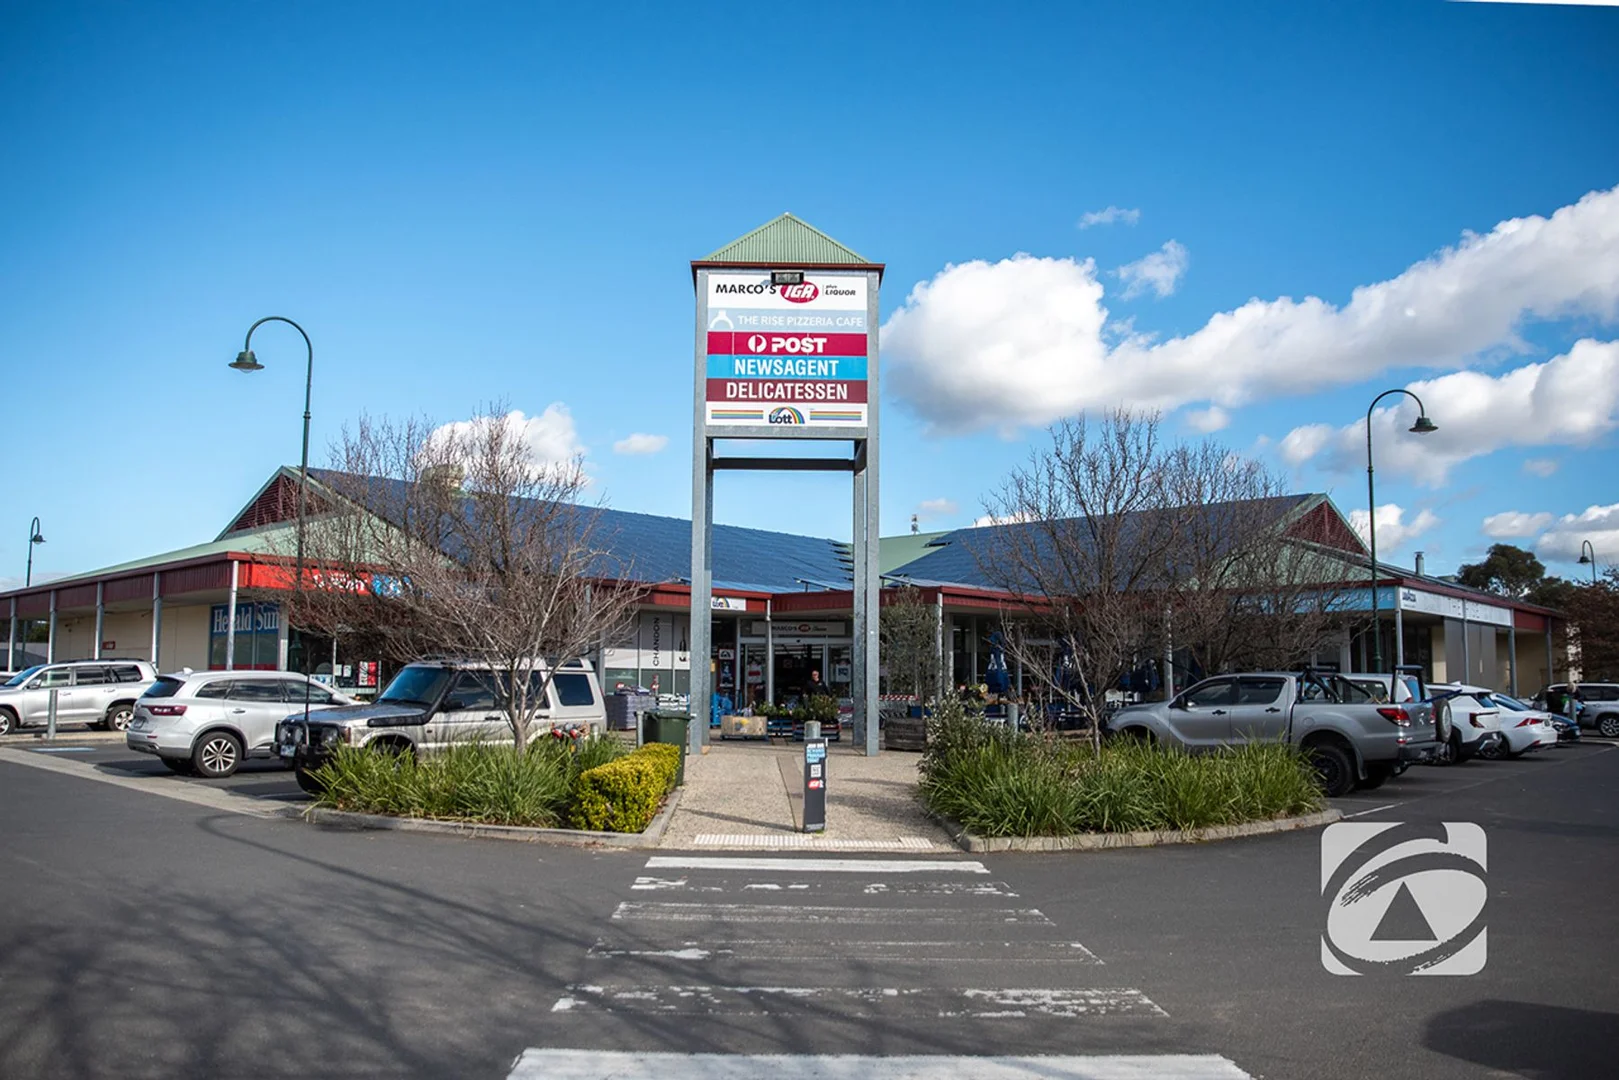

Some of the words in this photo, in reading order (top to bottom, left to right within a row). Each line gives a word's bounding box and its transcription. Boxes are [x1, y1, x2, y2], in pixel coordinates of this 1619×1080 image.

[716, 284, 777, 295] MARCO'S
[784, 284, 814, 299] IGA
[738, 315, 759, 325] THE
[762, 316, 784, 326] RISE
[788, 316, 833, 327] PIZZERIA
[836, 317, 863, 327] CAFE
[771, 337, 827, 353] POST
[734, 359, 839, 377] NEWSAGENT
[726, 382, 848, 400] DELICATESSEN
[213, 606, 252, 633] Heald
[652, 617, 660, 666] CHANDON
